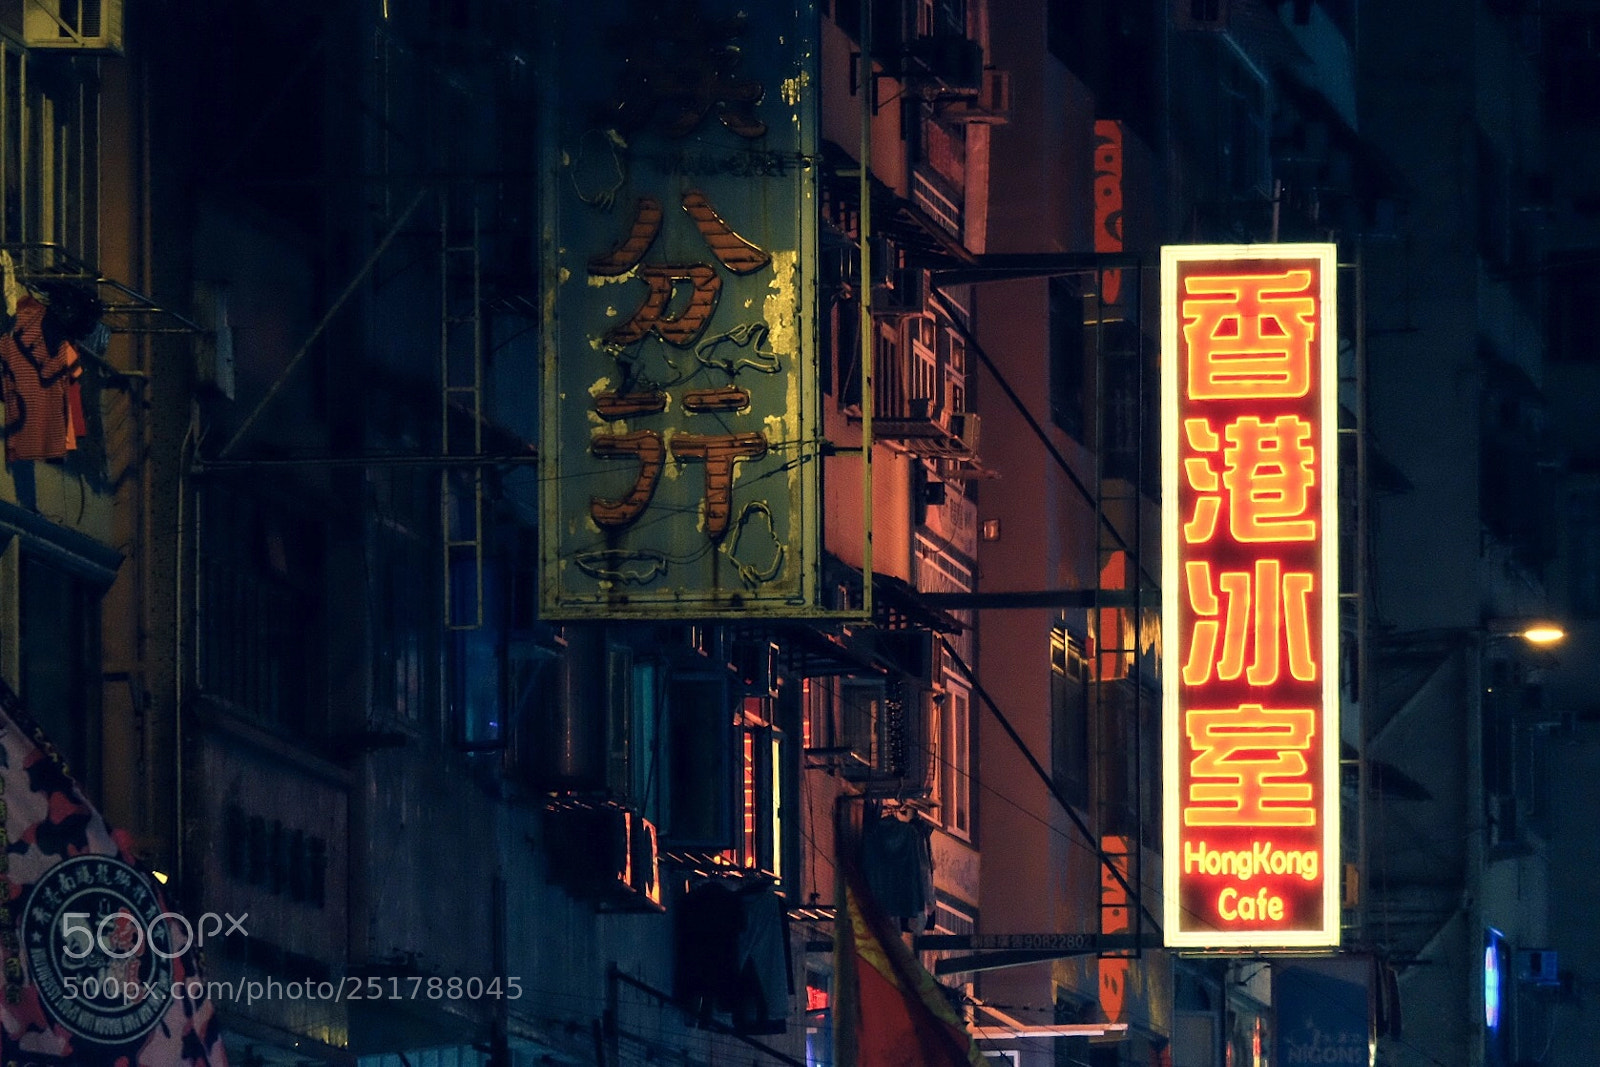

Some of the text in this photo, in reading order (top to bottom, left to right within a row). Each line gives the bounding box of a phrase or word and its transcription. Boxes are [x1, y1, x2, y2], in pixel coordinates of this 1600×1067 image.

[1183, 270, 1316, 827] 香港冰室
[1184, 841, 1318, 881] HongKong
[1217, 886, 1285, 923] Cafe
